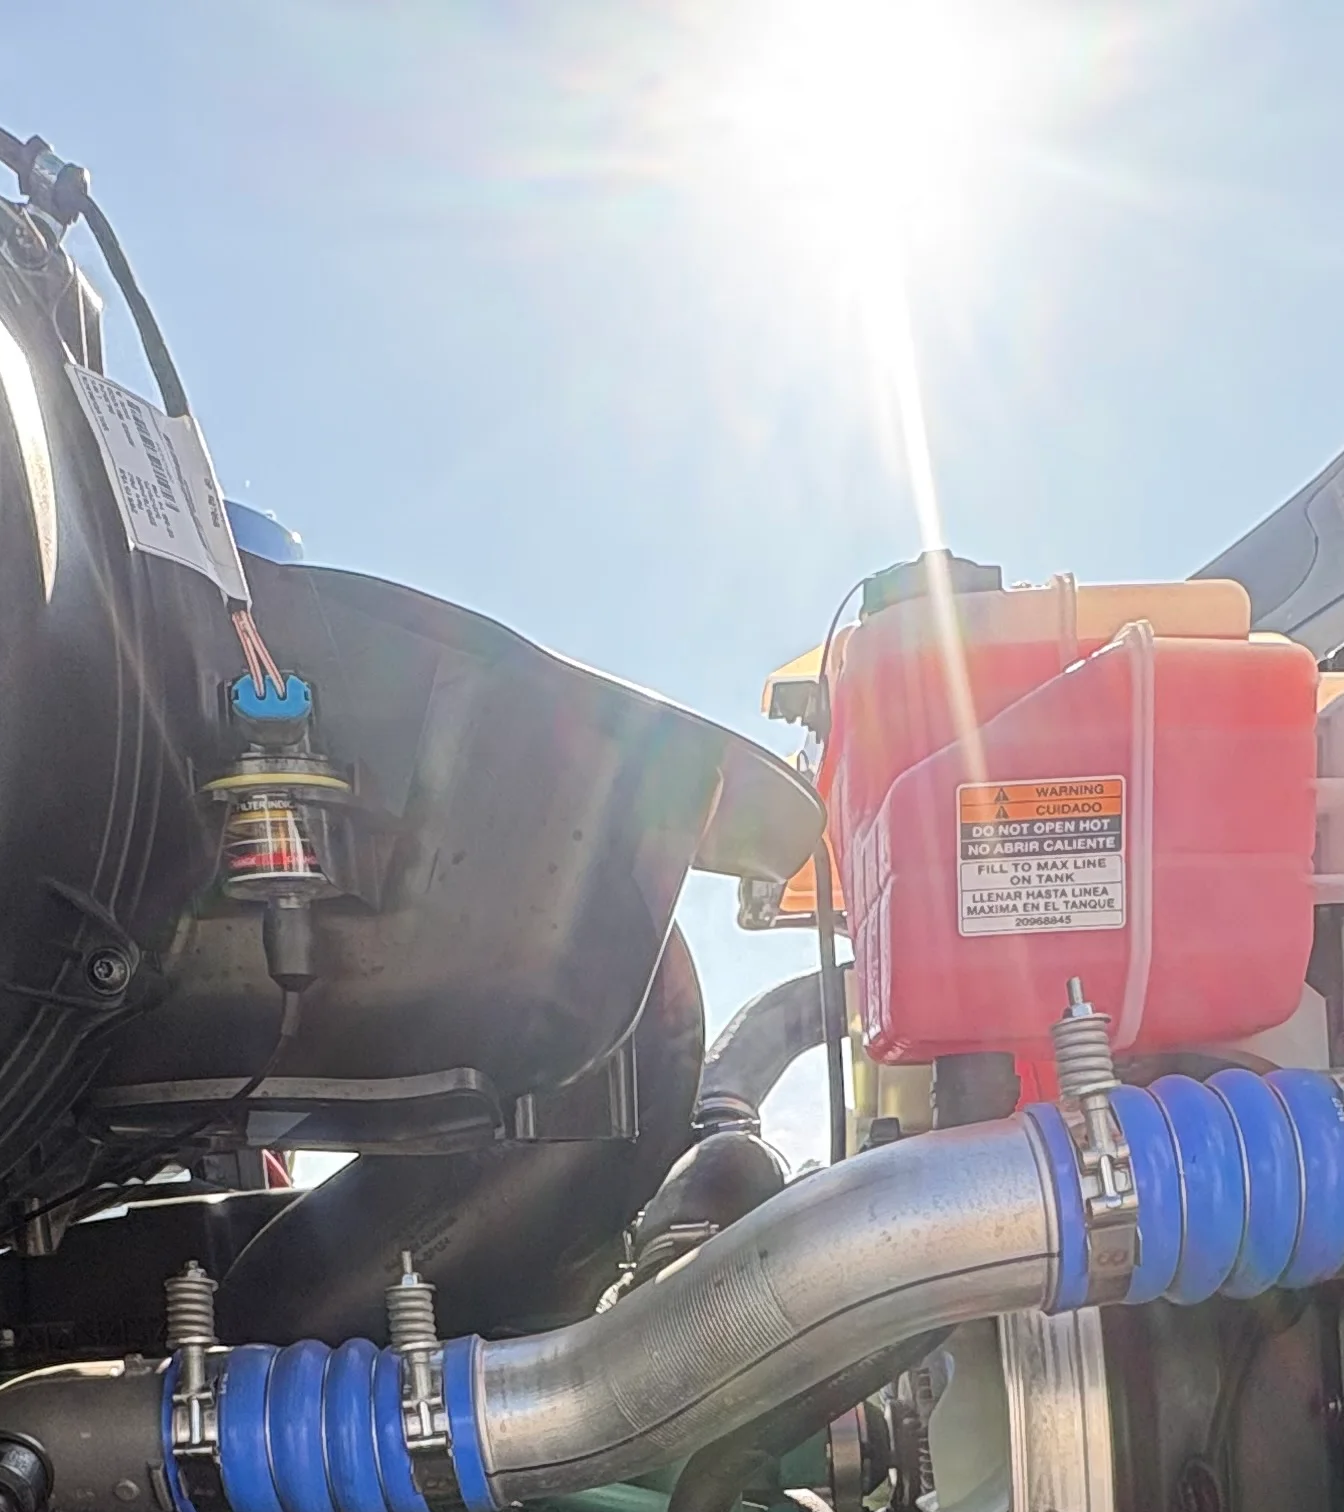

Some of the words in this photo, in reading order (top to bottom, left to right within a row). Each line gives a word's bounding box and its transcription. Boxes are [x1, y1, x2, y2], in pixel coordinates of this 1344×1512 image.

[1035, 784, 1105, 798] WARNING
[1035, 802, 1103, 816] CUIDADO
[972, 826, 995, 838] DO
[998, 823, 1031, 836] NOT
[1033, 821, 1076, 834] OPEN
[1079, 818, 1111, 832] HOT
[968, 844, 990, 856] NO
[993, 841, 1040, 855] ABRIR
[1043, 837, 1116, 852] CALIENTE
[977, 863, 1008, 875] FILL
[1011, 862, 1032, 873] TO
[1036, 859, 1069, 871] MAX
[1073, 857, 1108, 869] LINE
[1010, 874, 1032, 886] ON
[1036, 872, 1075, 885] TANK
[972, 891, 1023, 904] LLENAR
[1026, 888, 1068, 901] HASTA
[1071, 886, 1109, 899] LINEA
[966, 902, 1019, 916] MAXIMA
[1023, 901, 1041, 913] EN
[1044, 900, 1060, 912] EL
[1063, 898, 1116, 911] TANQUE
